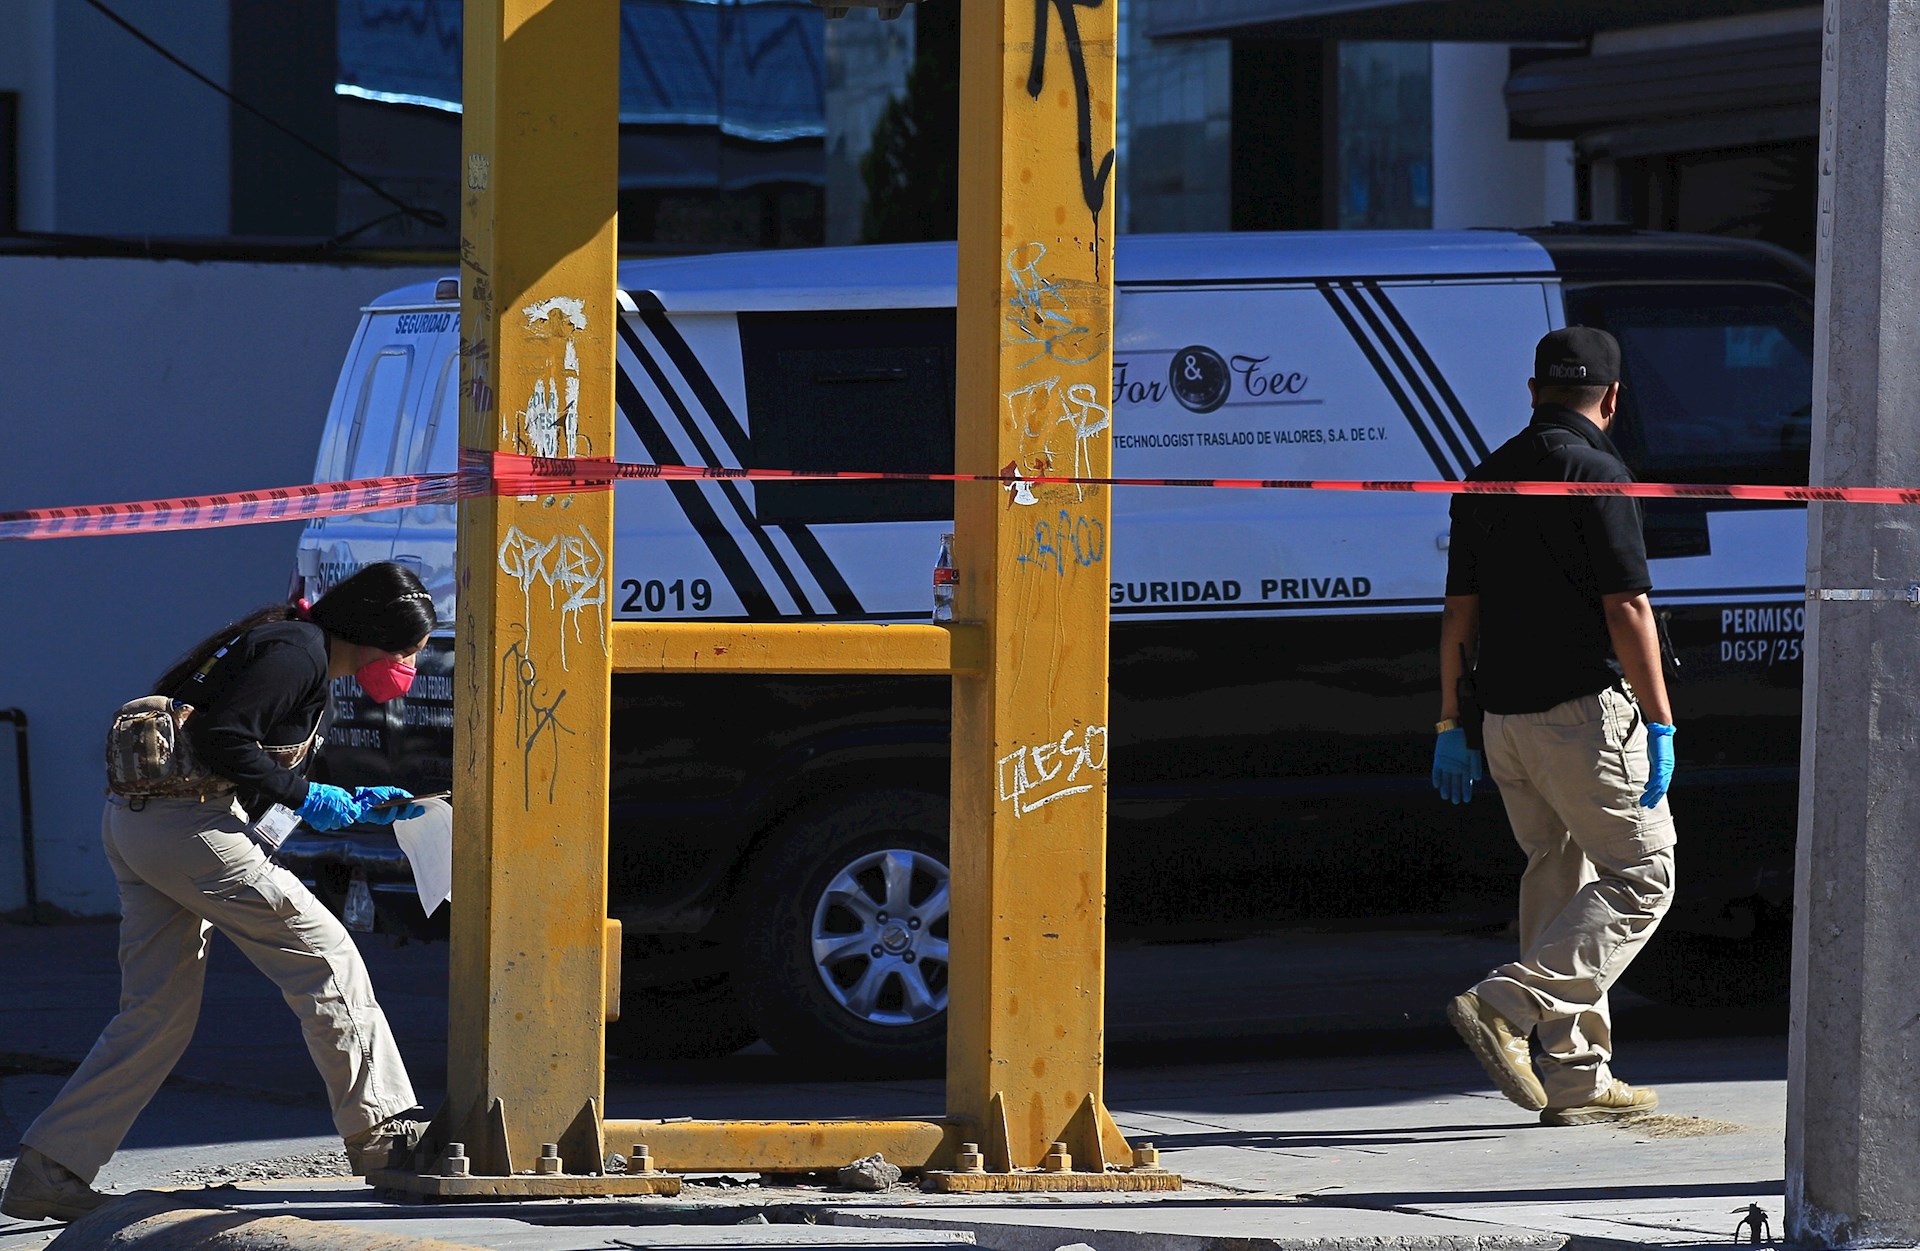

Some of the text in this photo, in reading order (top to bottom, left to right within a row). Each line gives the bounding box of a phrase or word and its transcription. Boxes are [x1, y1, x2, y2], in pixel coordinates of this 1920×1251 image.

[395, 314, 450, 334] SEGURIDAD
[1113, 427, 1388, 449] TECHNOLOGIST TRASLADO DE VALORES, S.A. DE C.V.
[620, 578, 713, 613] 2019
[1260, 576, 1372, 600] PRIVAD
[1721, 607, 1806, 634] PERMISO
